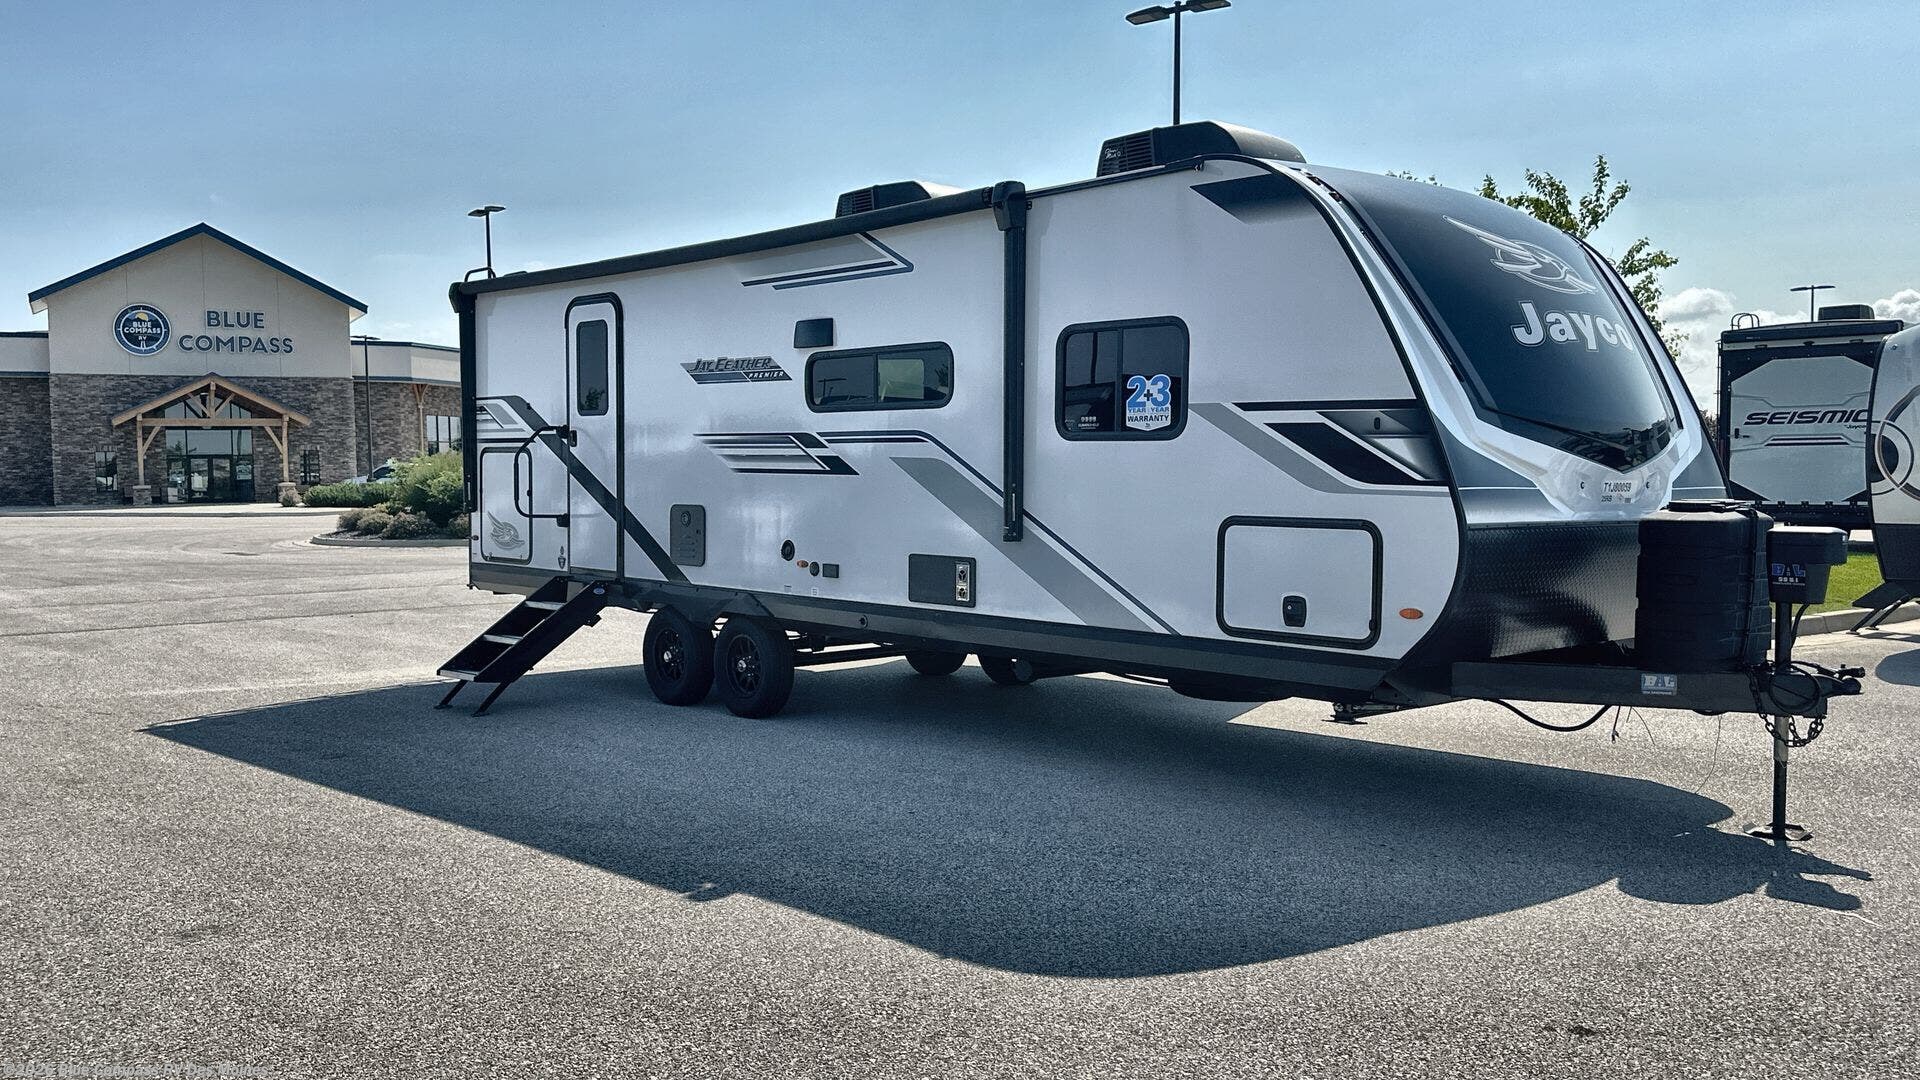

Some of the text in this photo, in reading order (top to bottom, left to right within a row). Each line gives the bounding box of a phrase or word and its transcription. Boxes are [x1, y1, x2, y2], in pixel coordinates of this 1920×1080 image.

[206, 310, 265, 329] BLUE
[1511, 301, 1634, 351] Jayco
[178, 334, 294, 354] COMPASS
[714, 356, 771, 371] FEATHER
[748, 371, 784, 379] PREMIER
[1127, 414, 1170, 423] WARRANTY
[1743, 409, 1868, 425] SEISMIC
